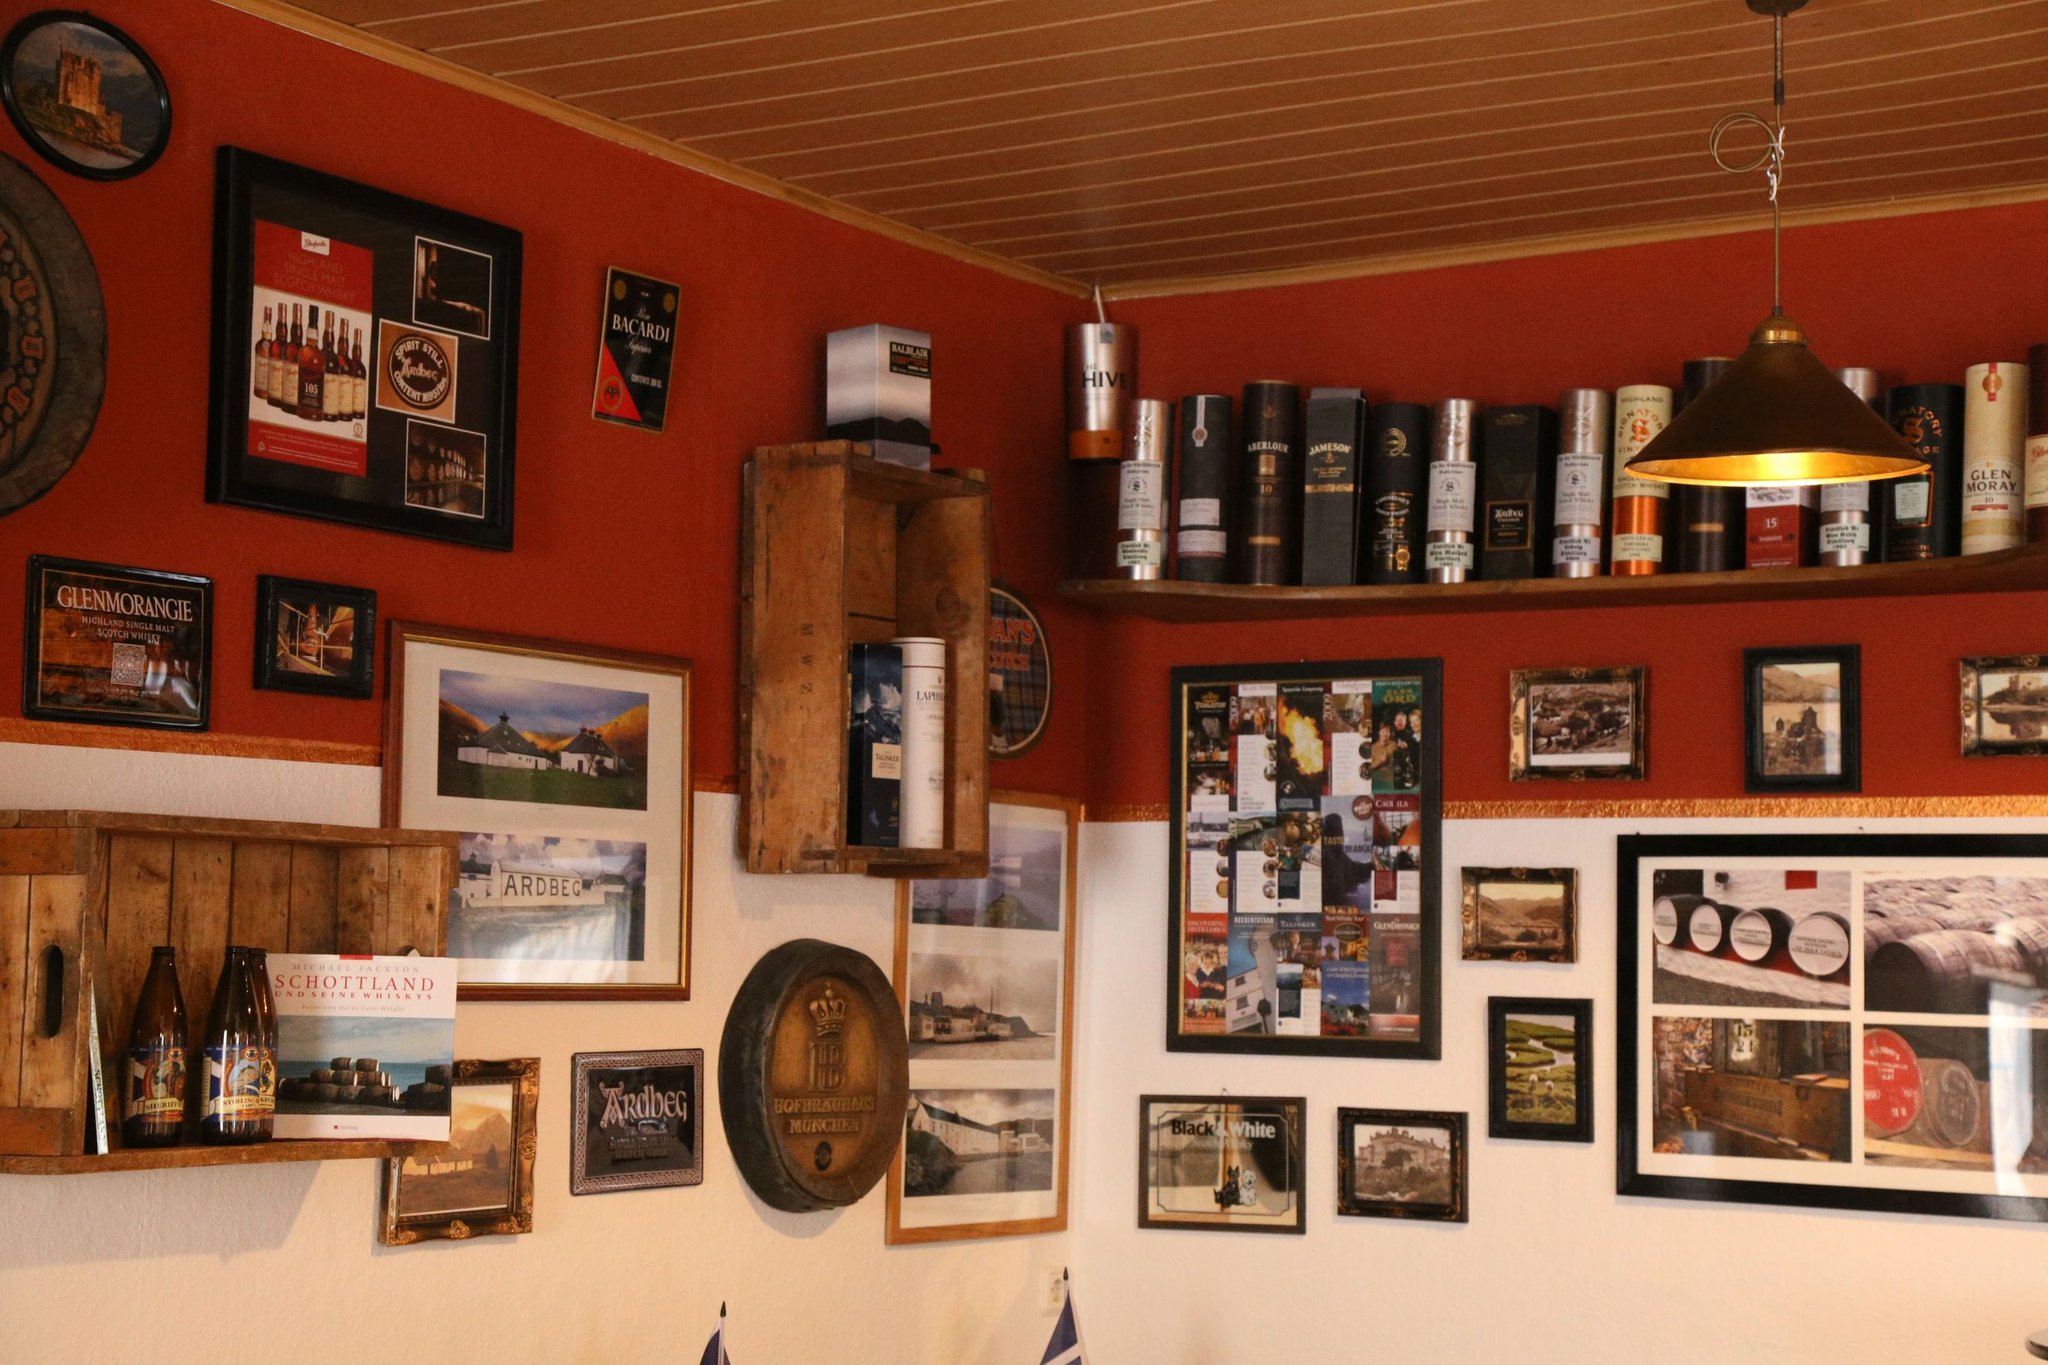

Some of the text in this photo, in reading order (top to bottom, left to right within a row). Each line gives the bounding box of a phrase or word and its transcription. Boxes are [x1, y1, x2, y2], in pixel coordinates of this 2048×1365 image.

[612, 314, 670, 343] BACARDI
[395, 340, 443, 368] SPIRIT STILL
[891, 343, 928, 358] BALBLAIR
[304, 381, 318, 394] 105
[394, 370, 421, 401] CONTENT
[1082, 371, 1128, 389] HIVE
[1620, 396, 1664, 404] HIGHLAND
[1618, 407, 1664, 438] SIGNATOR
[1247, 441, 1289, 453] ABERLOUR
[1308, 442, 1352, 456] JAMESON
[1971, 469, 2012, 481] GLEN
[1967, 481, 2017, 493] MORAY
[1766, 518, 1778, 529] 15
[57, 585, 193, 622] GLENMORANGIE
[82, 615, 176, 633] HIGHLAND SINGLE MALT
[990, 616, 1035, 645] AN'S
[97, 628, 160, 643] SCOTCH WHISKY
[1375, 800, 1395, 808] CAOL
[504, 874, 580, 897] ARDBEG
[1280, 920, 1316, 928] TALISKER
[292, 964, 420, 973] MICHAEL JACKSON
[275, 975, 434, 991] SCHOTTLAND
[1172, 1119, 1214, 1137] Black
[1231, 1121, 1276, 1139] White
